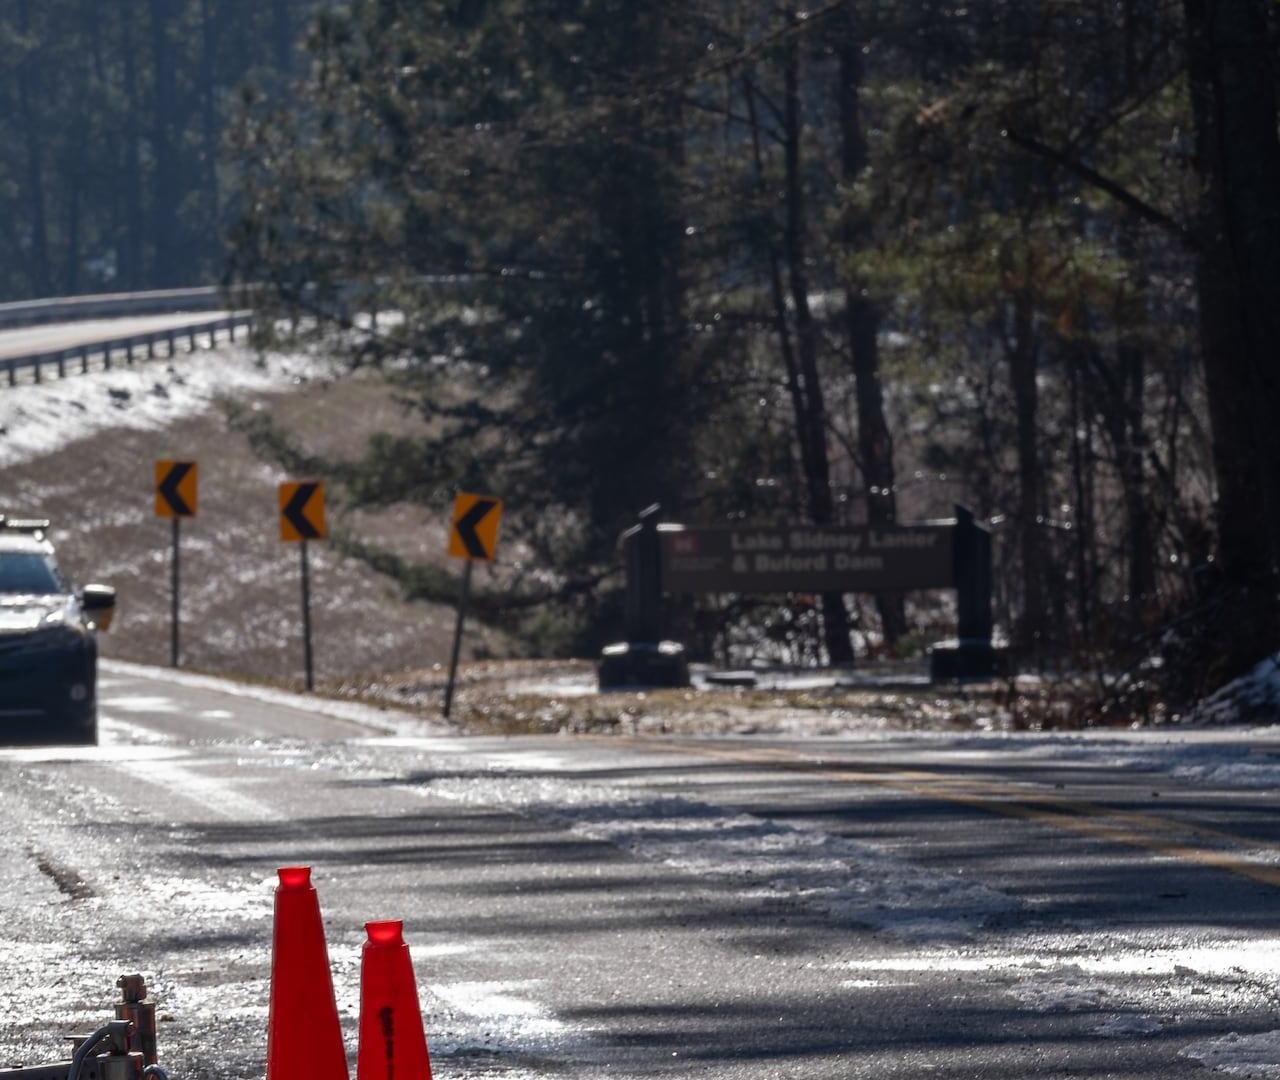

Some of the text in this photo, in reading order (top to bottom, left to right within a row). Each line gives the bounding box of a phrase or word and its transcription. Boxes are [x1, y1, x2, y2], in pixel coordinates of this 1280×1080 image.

[732, 530, 937, 552] Lake Sidney Lanier
[755, 554, 827, 571] Buford
[834, 554, 883, 570] Dam
